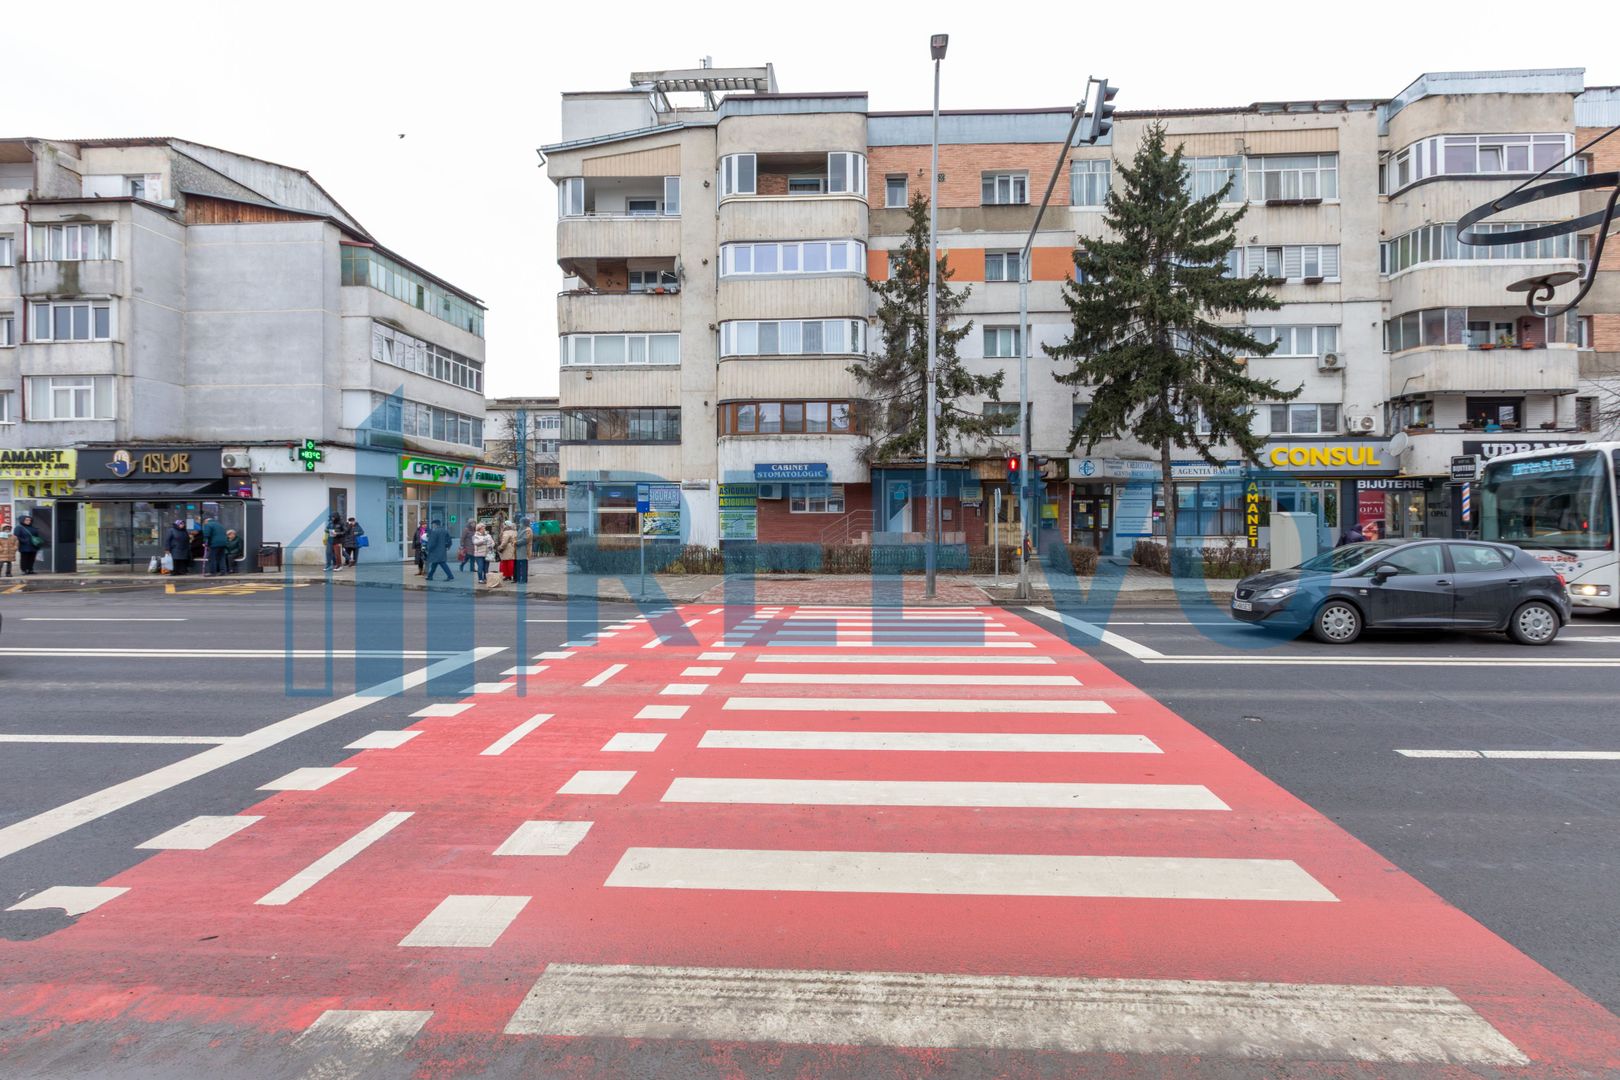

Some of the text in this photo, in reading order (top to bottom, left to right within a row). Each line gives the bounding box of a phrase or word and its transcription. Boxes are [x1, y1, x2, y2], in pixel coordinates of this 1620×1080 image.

[1, 450, 64, 462] AMANET
[1270, 447, 1381, 466] CONSUL
[1481, 443, 1567, 459] URB
[757, 470, 824, 478] STOMATOLOGIC
[1357, 479, 1424, 489] BIJUTERIE
[649, 490, 680, 501] SIGURARI
[1247, 482, 1258, 547] AMANET
